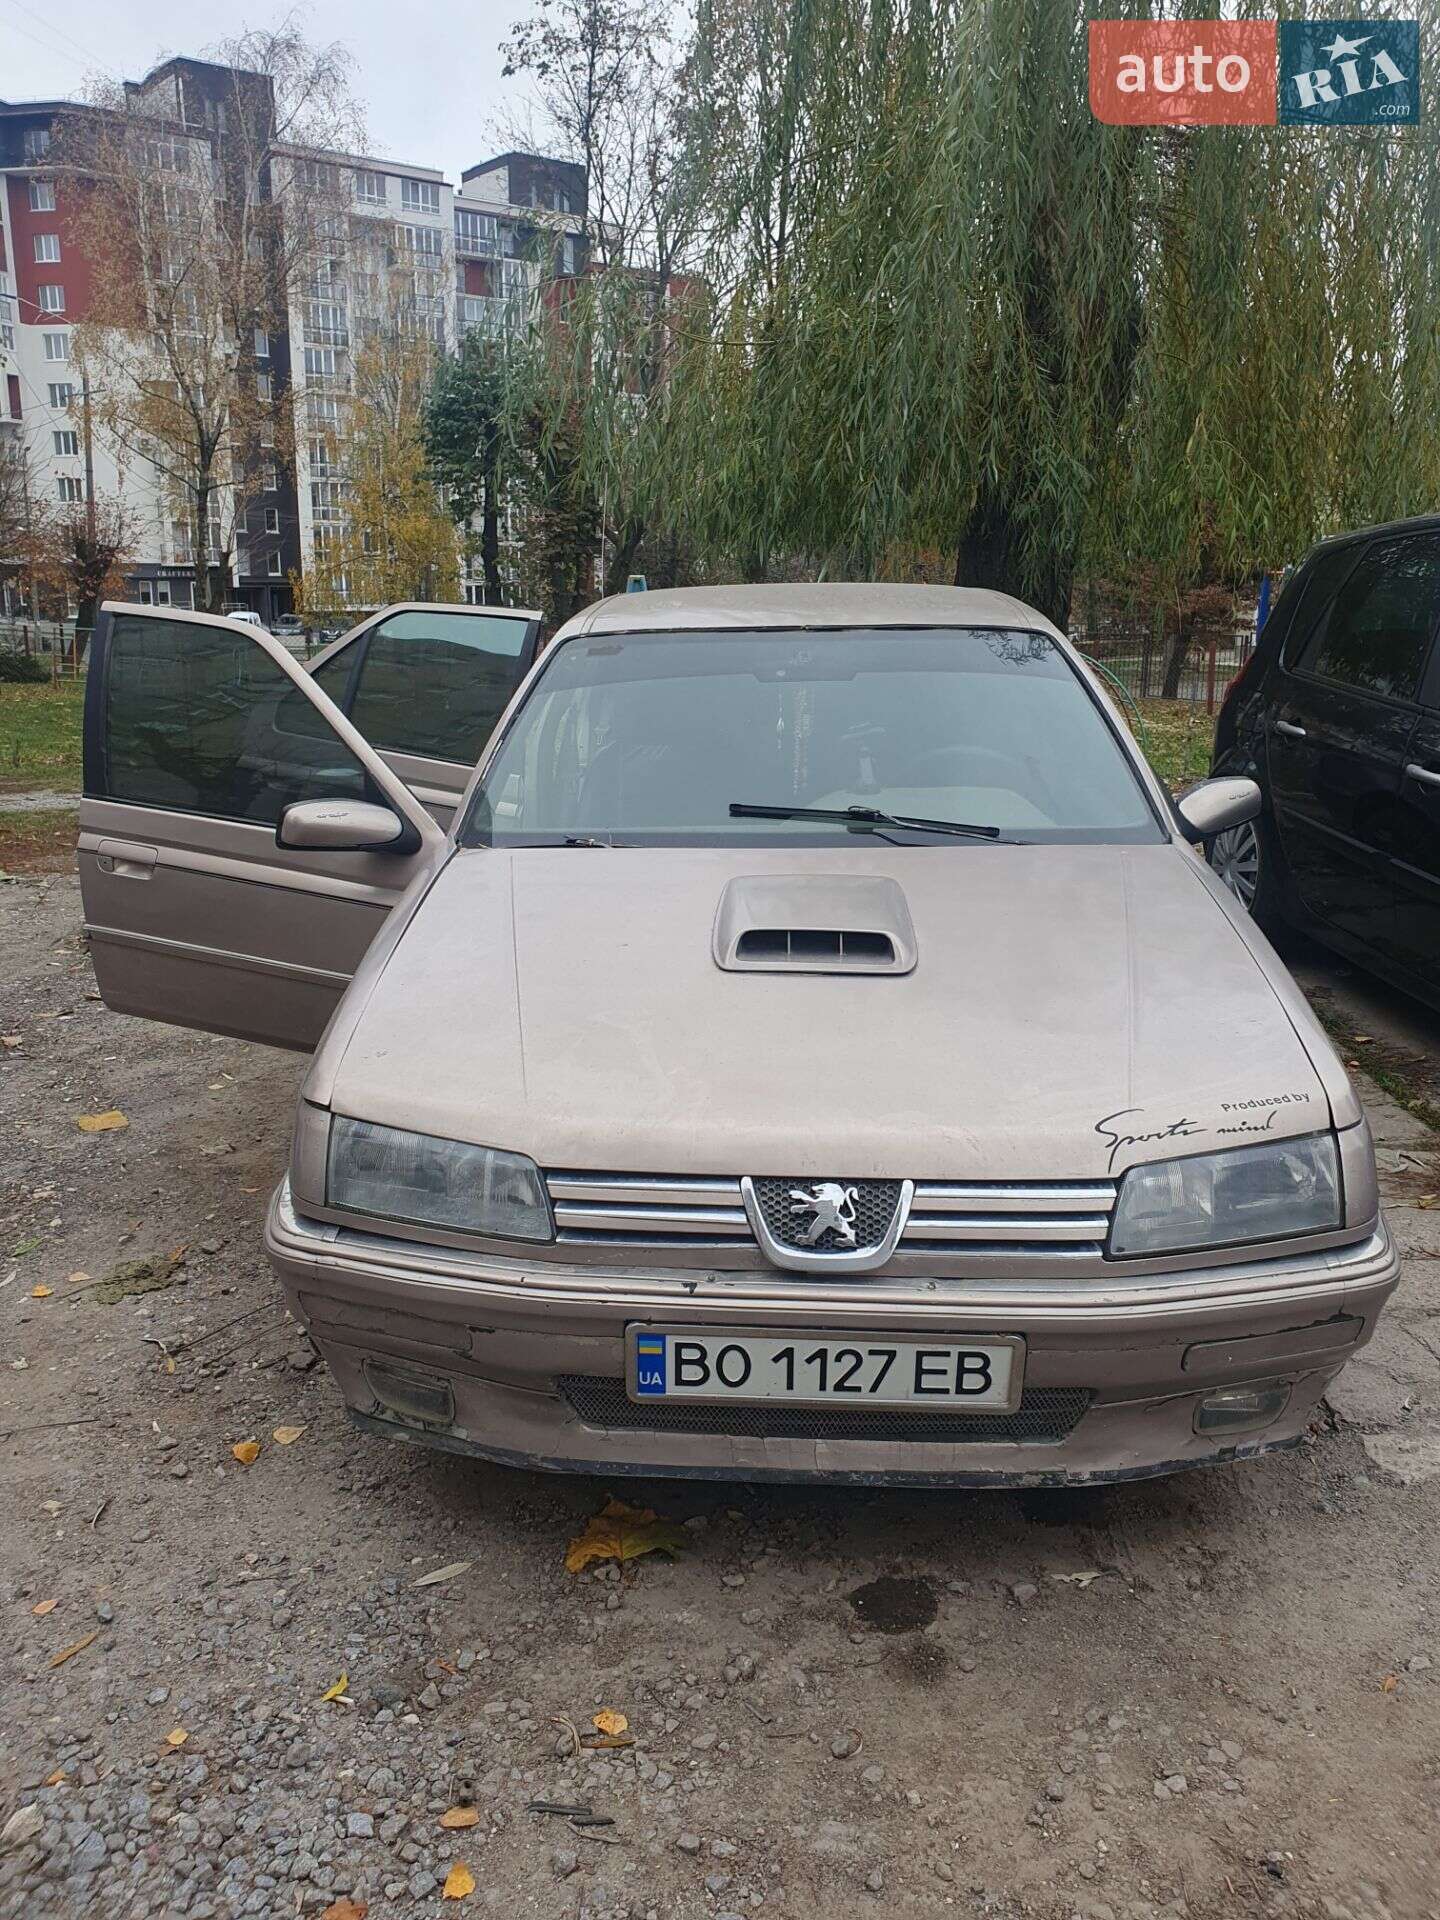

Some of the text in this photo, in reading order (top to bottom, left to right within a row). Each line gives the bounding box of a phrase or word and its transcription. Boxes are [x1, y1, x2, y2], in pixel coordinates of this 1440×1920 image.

[1221, 1091, 1311, 1112] Produced by
[1094, 1109, 1278, 1174] Sports mind
[639, 1371, 662, 1386] UA
[674, 1342, 993, 1394] BO 1127 EB
